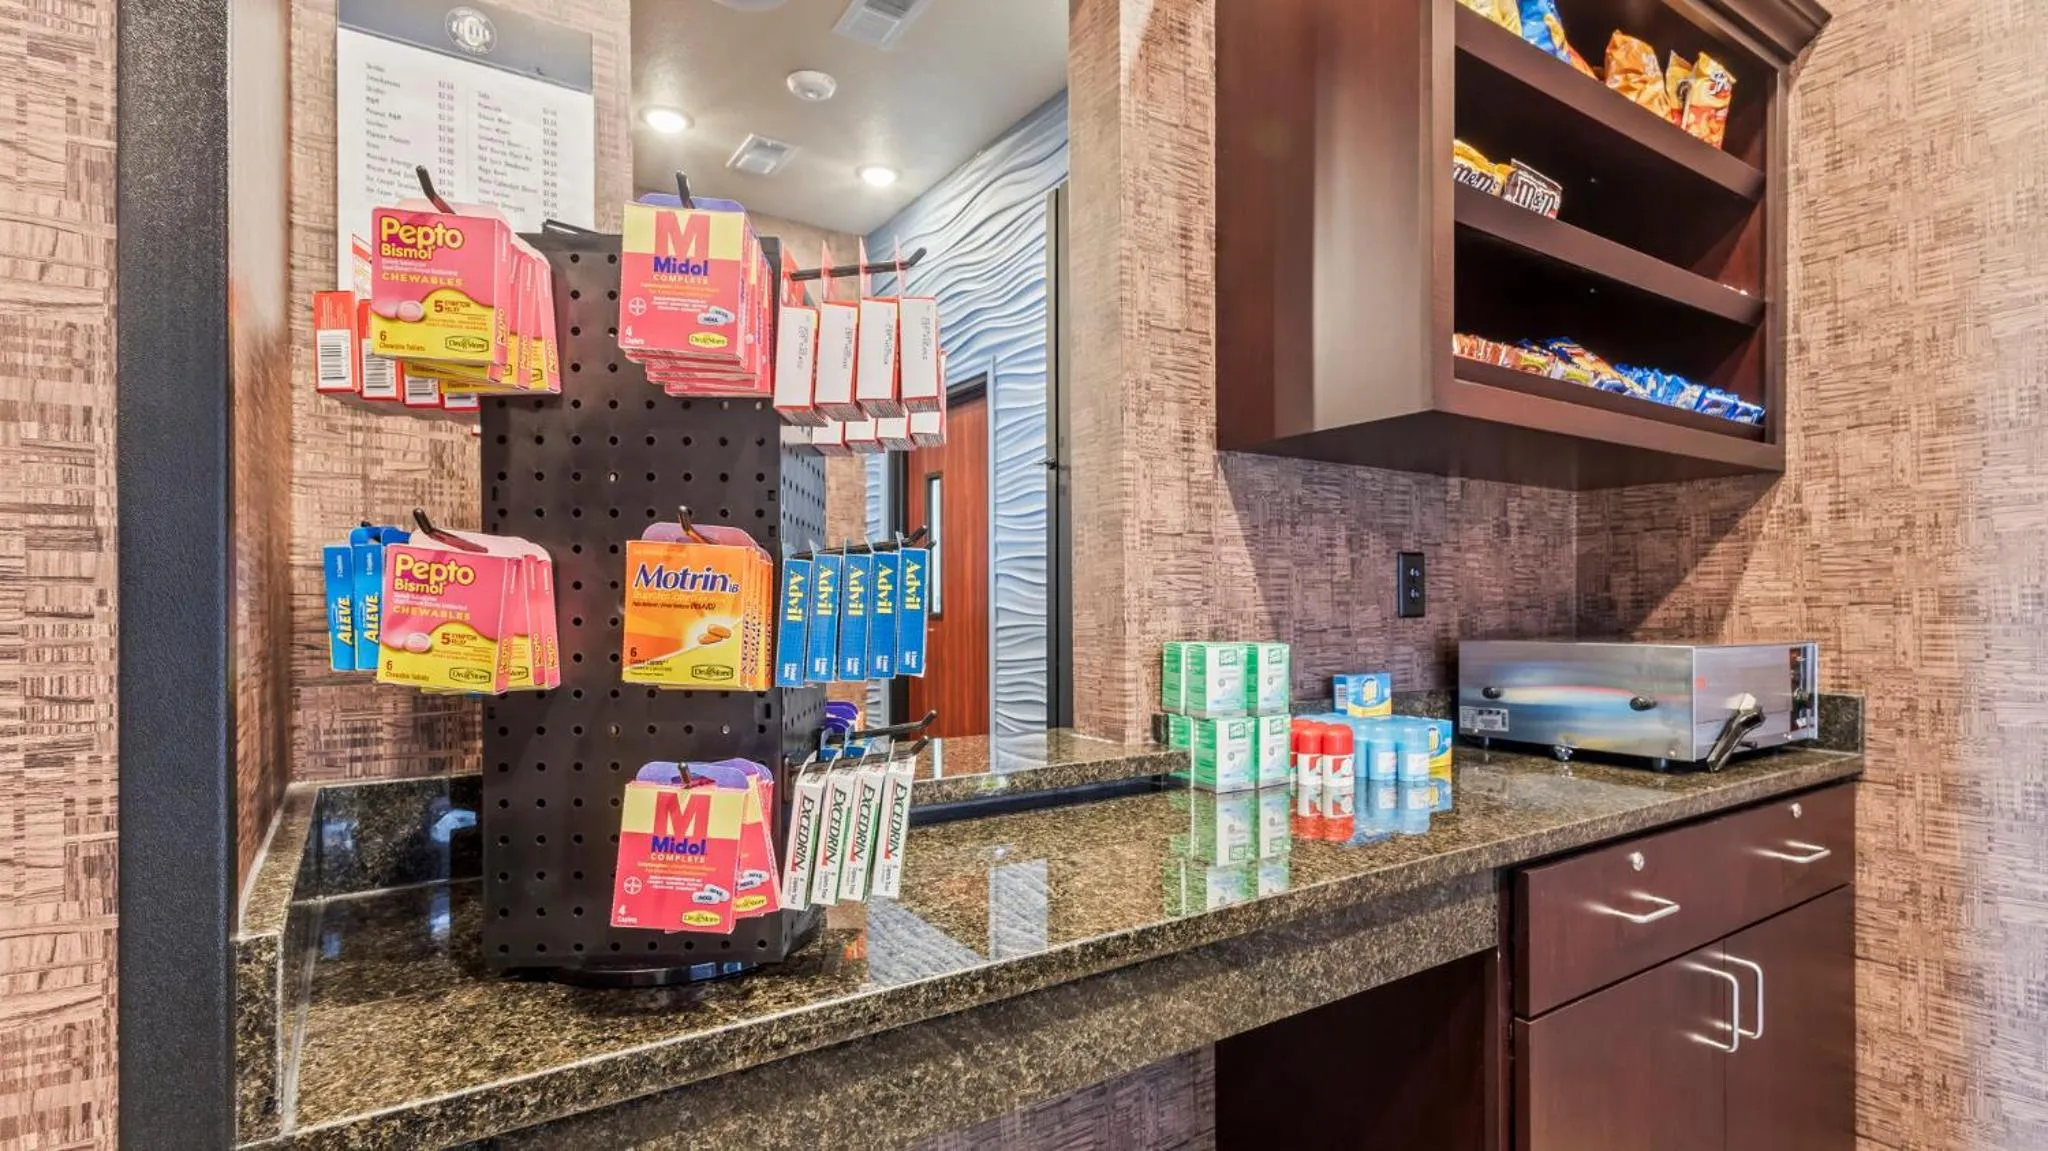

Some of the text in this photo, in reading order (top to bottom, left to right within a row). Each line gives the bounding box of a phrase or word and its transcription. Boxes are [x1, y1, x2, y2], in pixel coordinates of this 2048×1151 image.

[380, 216, 465, 250] Pepto
[380, 242, 435, 260] Bismol
[653, 256, 709, 276] Midol
[382, 273, 464, 287] CHEWABLES
[652, 274, 709, 286] COMPLETE
[433, 300, 444, 313] 5
[380, 331, 387, 342] 6
[625, 326, 633, 336] 4
[393, 552, 476, 586] Pepto
[634, 563, 730, 592] Motrin
[393, 577, 445, 596] Bismol
[817, 564, 834, 616] Advil
[848, 565, 864, 616] Advil
[877, 562, 893, 614] Advil
[905, 559, 921, 610] Advil
[787, 569, 804, 621] Advil
[392, 605, 471, 621] CHEWABLES
[440, 633, 451, 645] 5
[630, 647, 637, 658] 6
[386, 660, 393, 671] 6
[826, 787, 846, 864] EXCEDRIN
[855, 783, 875, 860] EXCEDRIN
[888, 782, 907, 858] EXCEDRIN
[795, 794, 815, 870] EXCEDRIN
[651, 836, 707, 855] Midol
[650, 854, 706, 864] COMPLETE
[618, 905, 626, 915] 4
